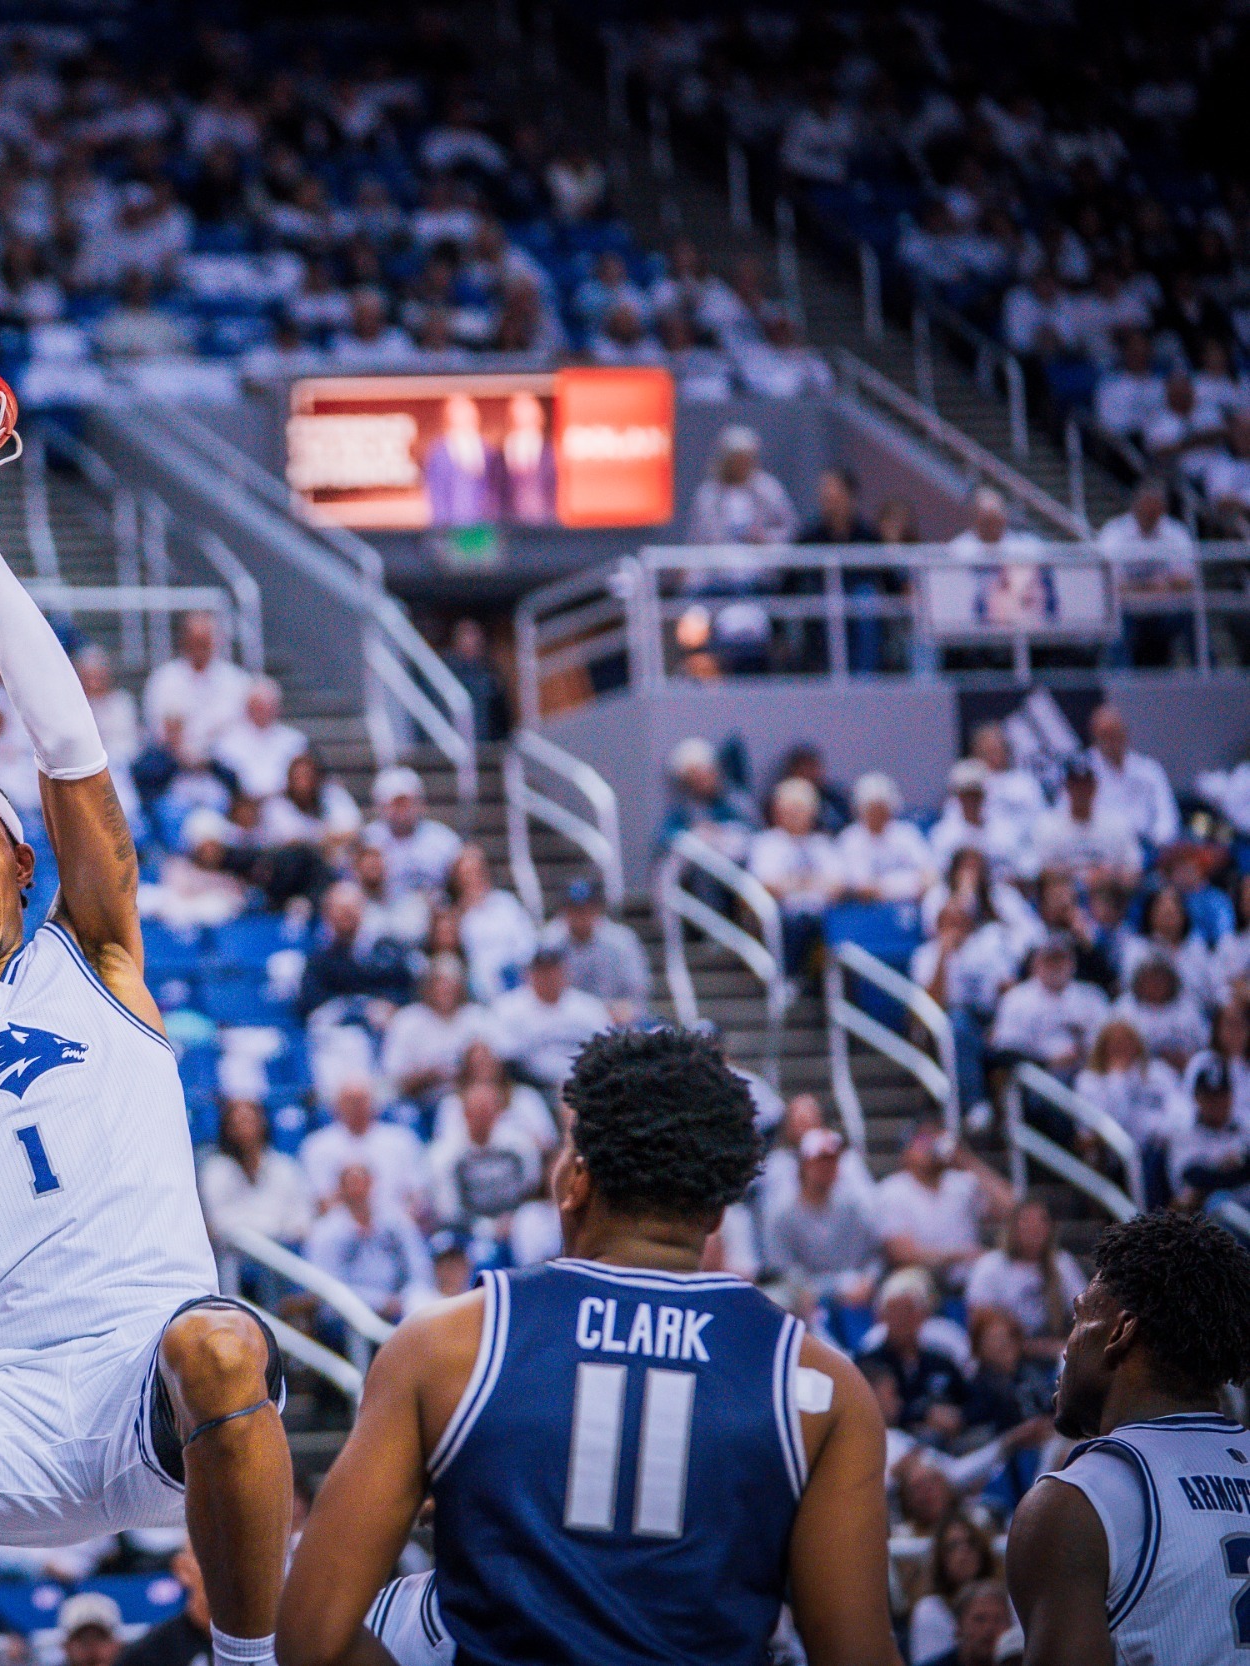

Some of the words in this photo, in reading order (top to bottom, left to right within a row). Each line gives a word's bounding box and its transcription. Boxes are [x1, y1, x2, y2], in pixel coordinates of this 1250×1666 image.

[12, 1121, 64, 1200] 1
[575, 1296, 715, 1363] CLARK
[562, 1361, 698, 1540] 11
[1178, 1474, 1250, 1516] ARMOT
